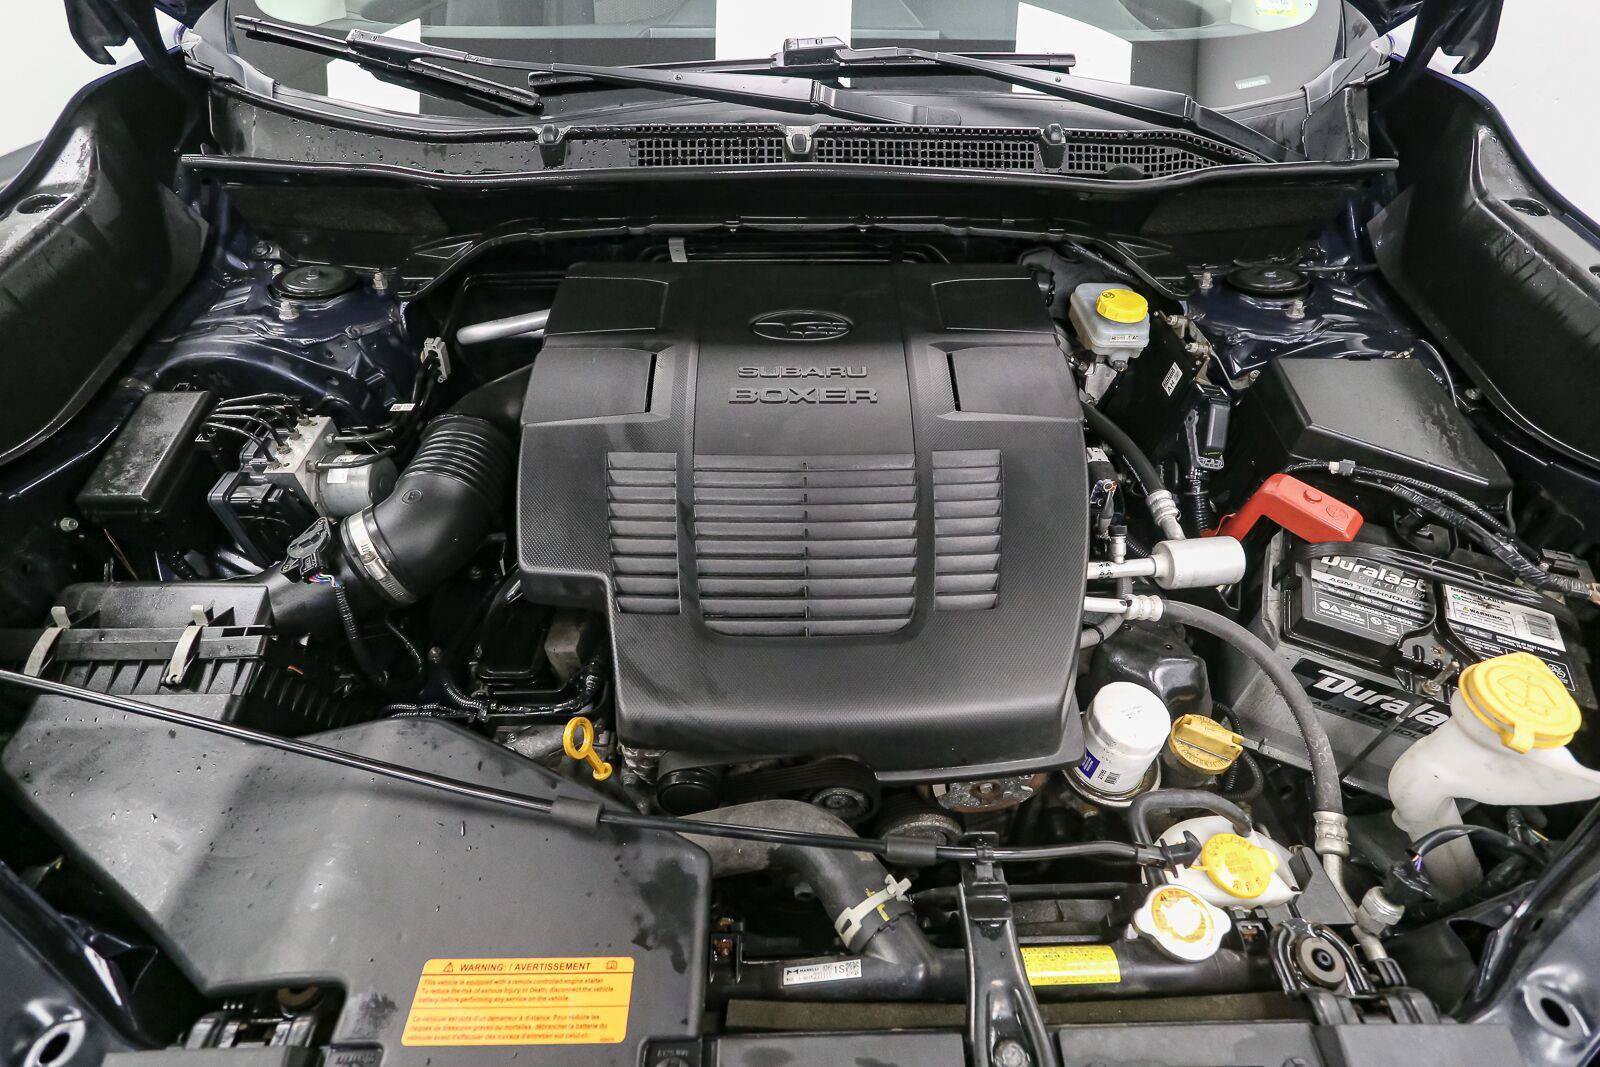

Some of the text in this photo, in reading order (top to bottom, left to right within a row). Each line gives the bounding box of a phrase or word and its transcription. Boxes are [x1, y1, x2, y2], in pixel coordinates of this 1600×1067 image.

[737, 366, 868, 378] SUBARU
[728, 387, 878, 404] BOXER
[1329, 577, 1354, 588] AGM
[1312, 669, 1449, 726] Durala
[1313, 701, 1346, 714] AGM
[460, 963, 504, 972] WARNING
[514, 962, 592, 972] AVERTISSEMENT
